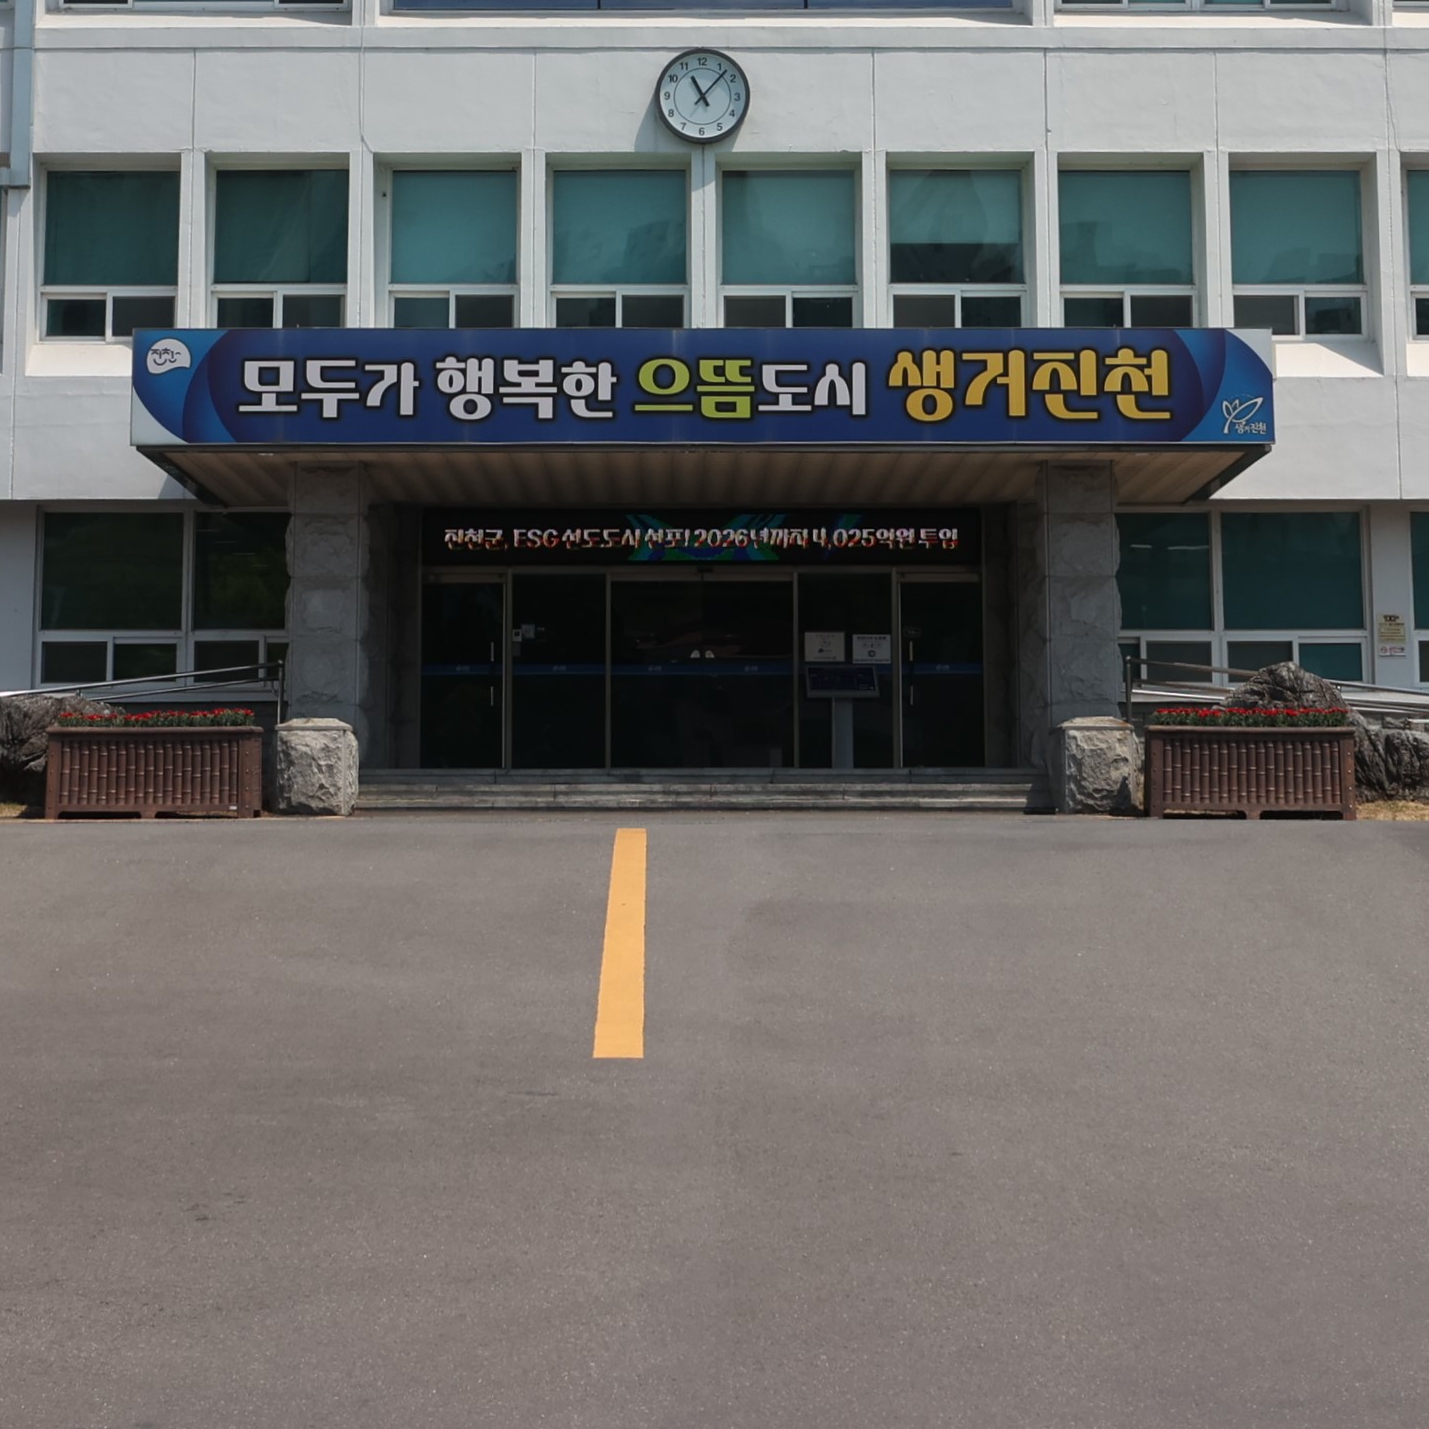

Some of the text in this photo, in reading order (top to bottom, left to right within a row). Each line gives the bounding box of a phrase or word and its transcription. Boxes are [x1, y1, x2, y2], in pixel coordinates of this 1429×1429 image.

[698, 57, 708, 66] 12
[680, 62, 689, 70] 11
[717, 63, 722, 71] 1
[668, 74, 678, 83] 10
[730, 74, 736, 83] 2
[664, 92, 670, 100] 9
[734, 92, 740, 101] 3
[668, 109, 674, 117] 8
[729, 109, 735, 117] 4
[680, 122, 686, 130] 7
[717, 123, 723, 131] 5
[699, 127, 705, 136] 6
[238, 358, 419, 418] 모두가
[435, 356, 618, 421] 행복한
[888, 347, 1172, 422] 생거진천
[513, 528, 559, 549] ESG
[693, 528, 809, 550] 2026년까지
[918, 528, 960, 550] 투입
